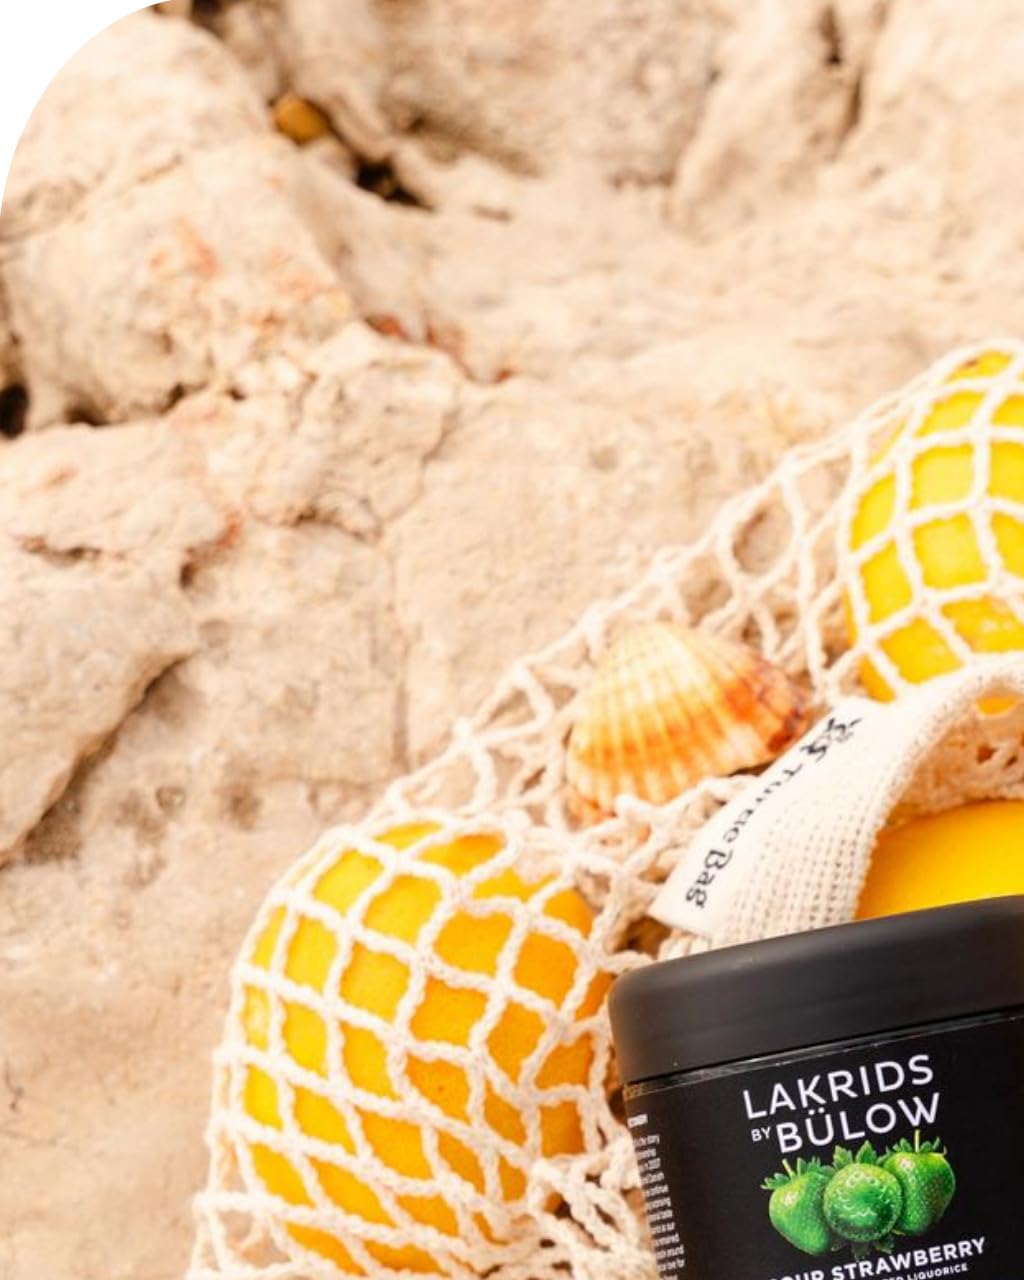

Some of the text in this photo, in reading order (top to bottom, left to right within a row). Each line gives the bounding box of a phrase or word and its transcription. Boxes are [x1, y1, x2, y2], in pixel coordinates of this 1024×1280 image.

[685, 848, 734, 908] Bag
[742, 1055, 934, 1120] LAKRIDS
[751, 1092, 942, 1154] BY BÜLOW
